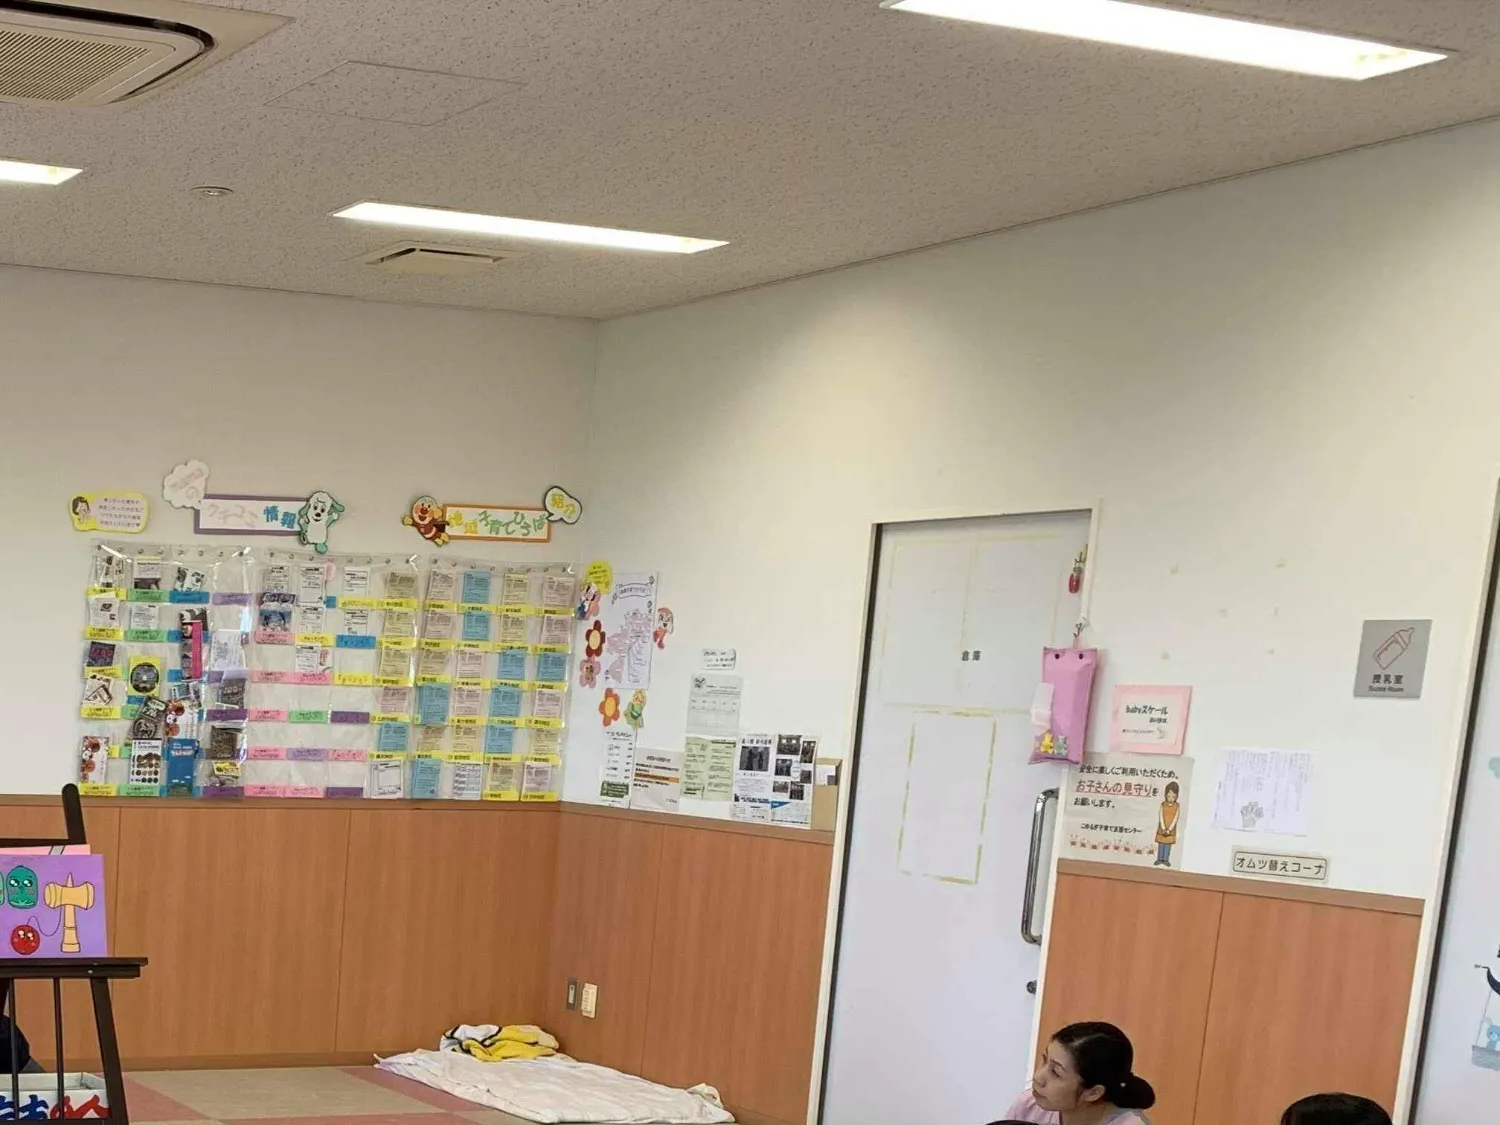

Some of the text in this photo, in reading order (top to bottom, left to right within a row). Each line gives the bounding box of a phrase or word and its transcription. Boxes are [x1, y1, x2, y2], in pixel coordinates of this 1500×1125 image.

[551, 492, 577, 517] 紹介
[1075, 779, 1159, 799] お子さんの見守りを
